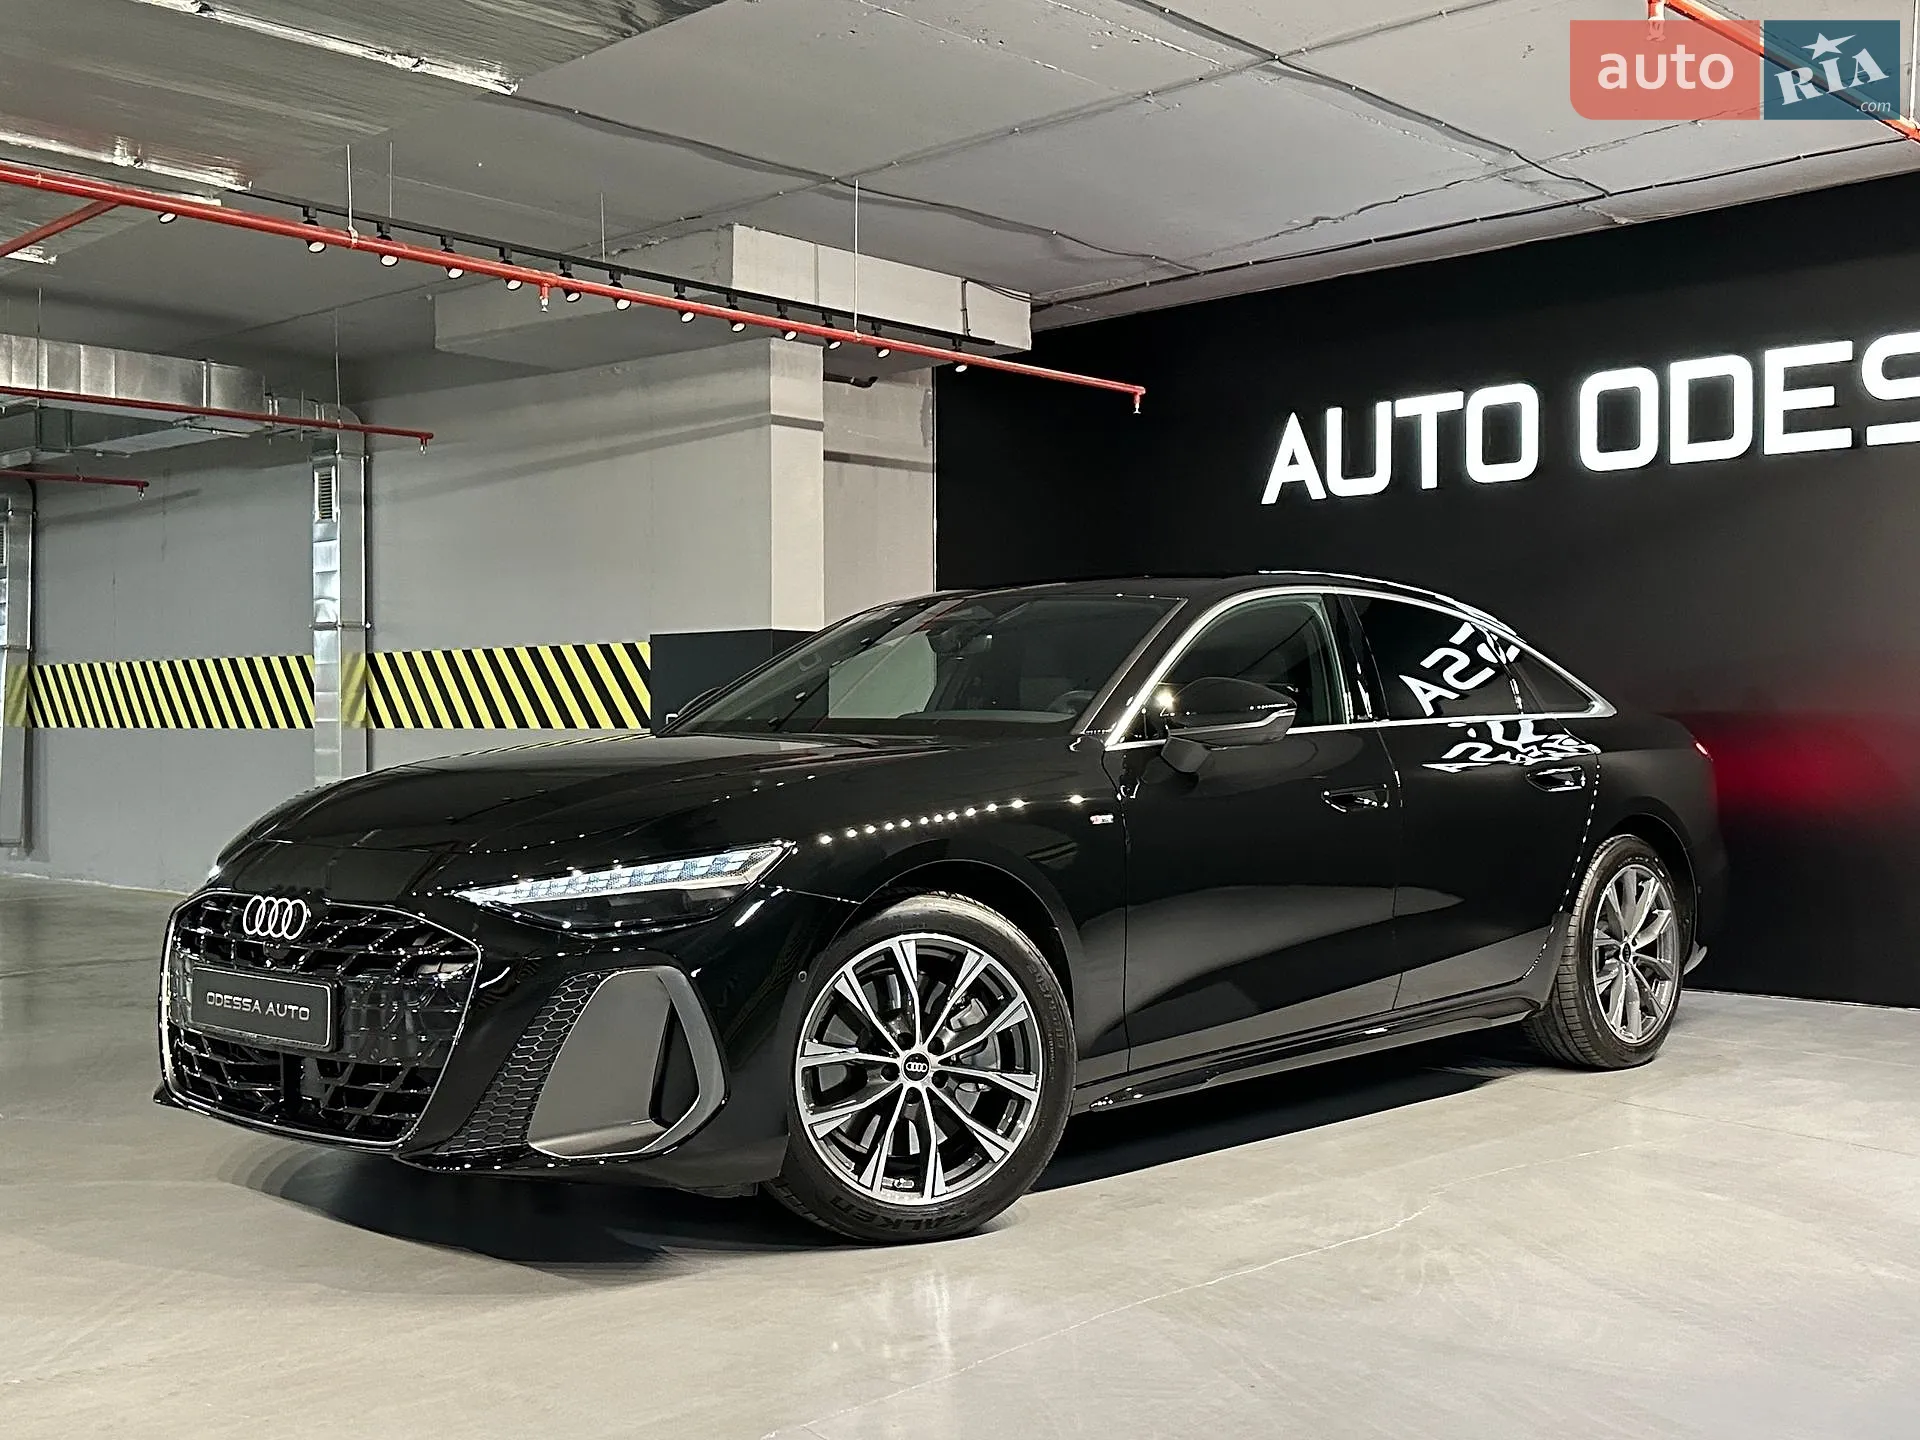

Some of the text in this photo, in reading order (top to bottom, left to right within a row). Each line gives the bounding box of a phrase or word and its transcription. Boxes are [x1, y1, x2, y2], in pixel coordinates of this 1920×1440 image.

[1261, 382, 1539, 505] AUTO
[206, 991, 310, 1021] ODESSA AUTO
